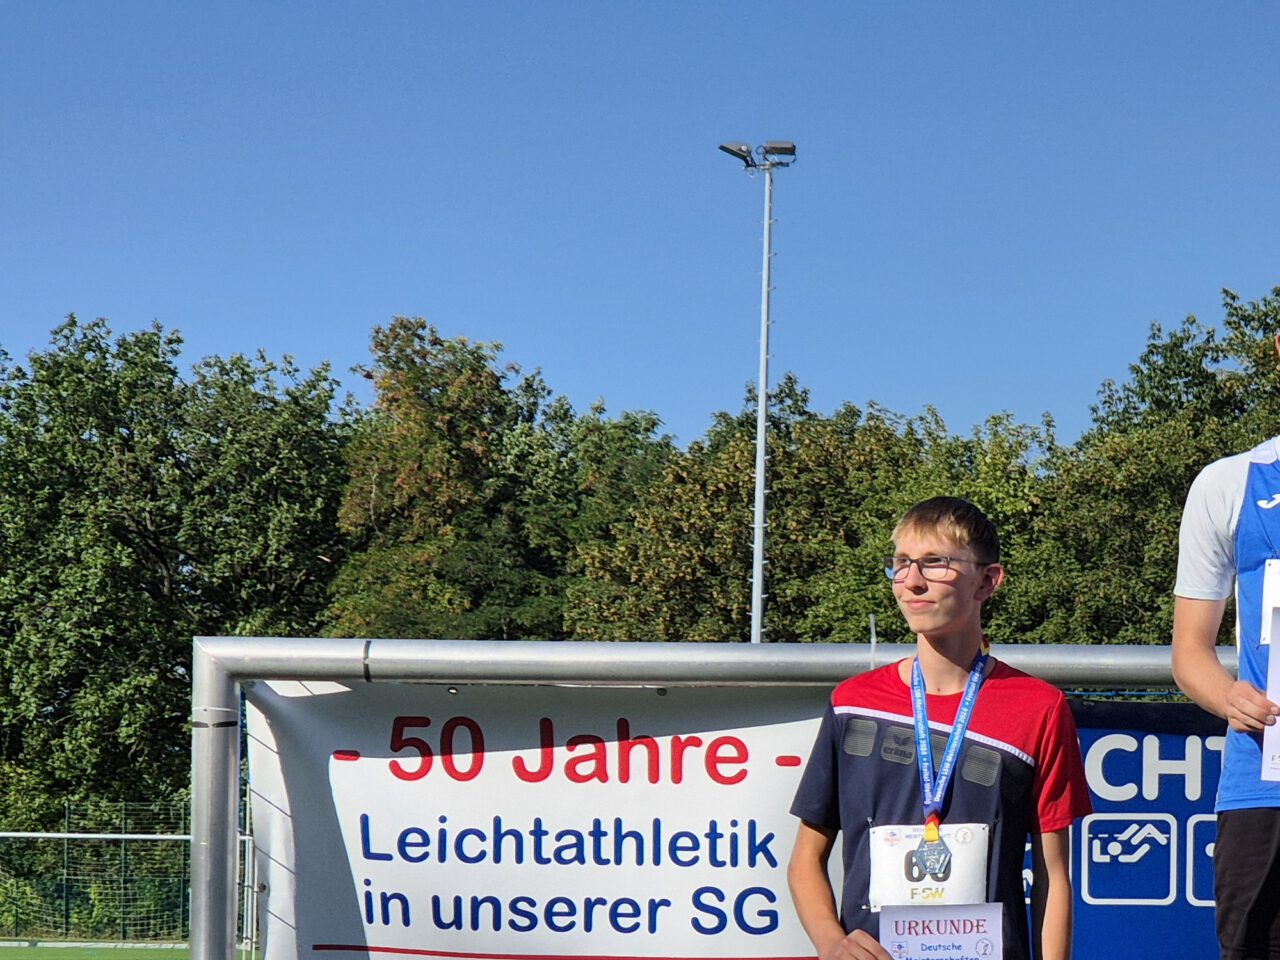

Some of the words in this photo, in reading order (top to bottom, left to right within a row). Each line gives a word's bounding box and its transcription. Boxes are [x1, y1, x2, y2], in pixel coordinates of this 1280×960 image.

[957, 706, 968, 723] 2024
[389, 716, 485, 782] 50
[513, 717, 749, 785] Jahre
[359, 813, 778, 867] Leichtathletik
[363, 880, 411, 926] in
[432, 892, 671, 933] unserer
[690, 885, 779, 935] SG
[894, 919, 988, 936] URKUNDE
[920, 943, 962, 952] Deutsche
